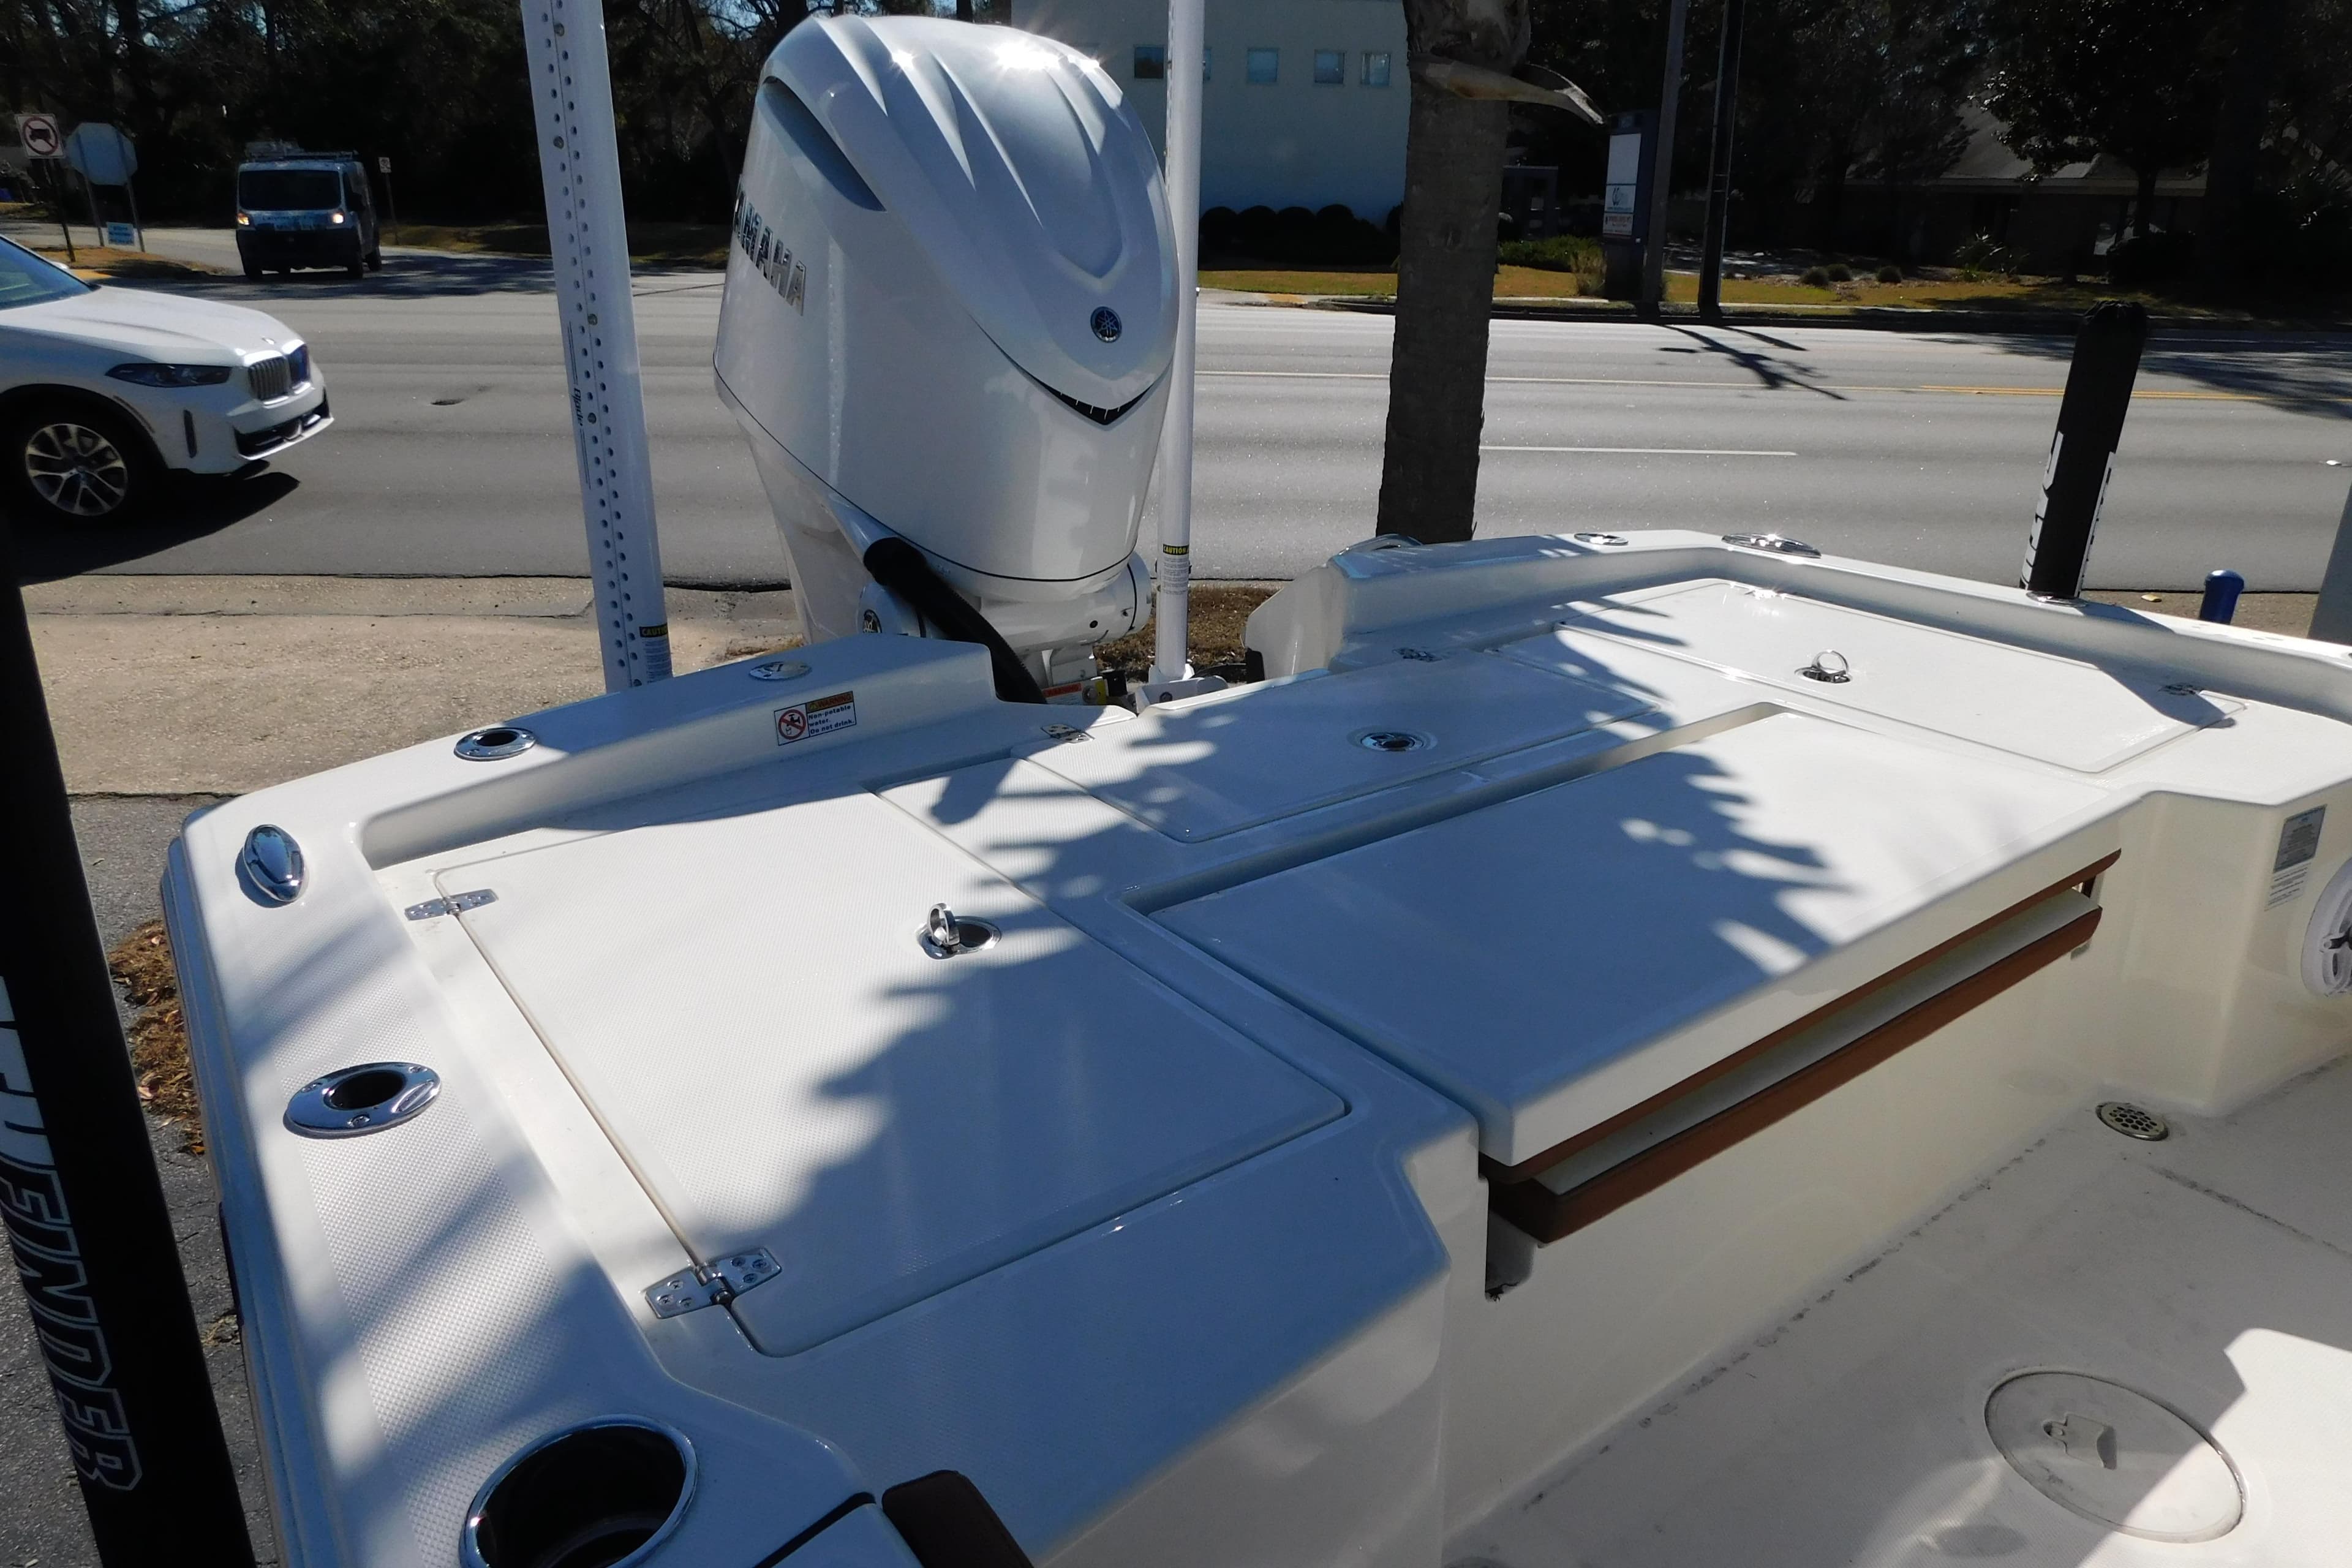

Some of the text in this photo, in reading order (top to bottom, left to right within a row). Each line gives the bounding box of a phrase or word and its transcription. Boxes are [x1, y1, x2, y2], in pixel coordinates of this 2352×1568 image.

[1164, 544, 1186, 554] CAUTION
[818, 693, 851, 708] WARNING
[809, 706, 851, 720] Non-potable
[834, 719, 854, 728] drink.
